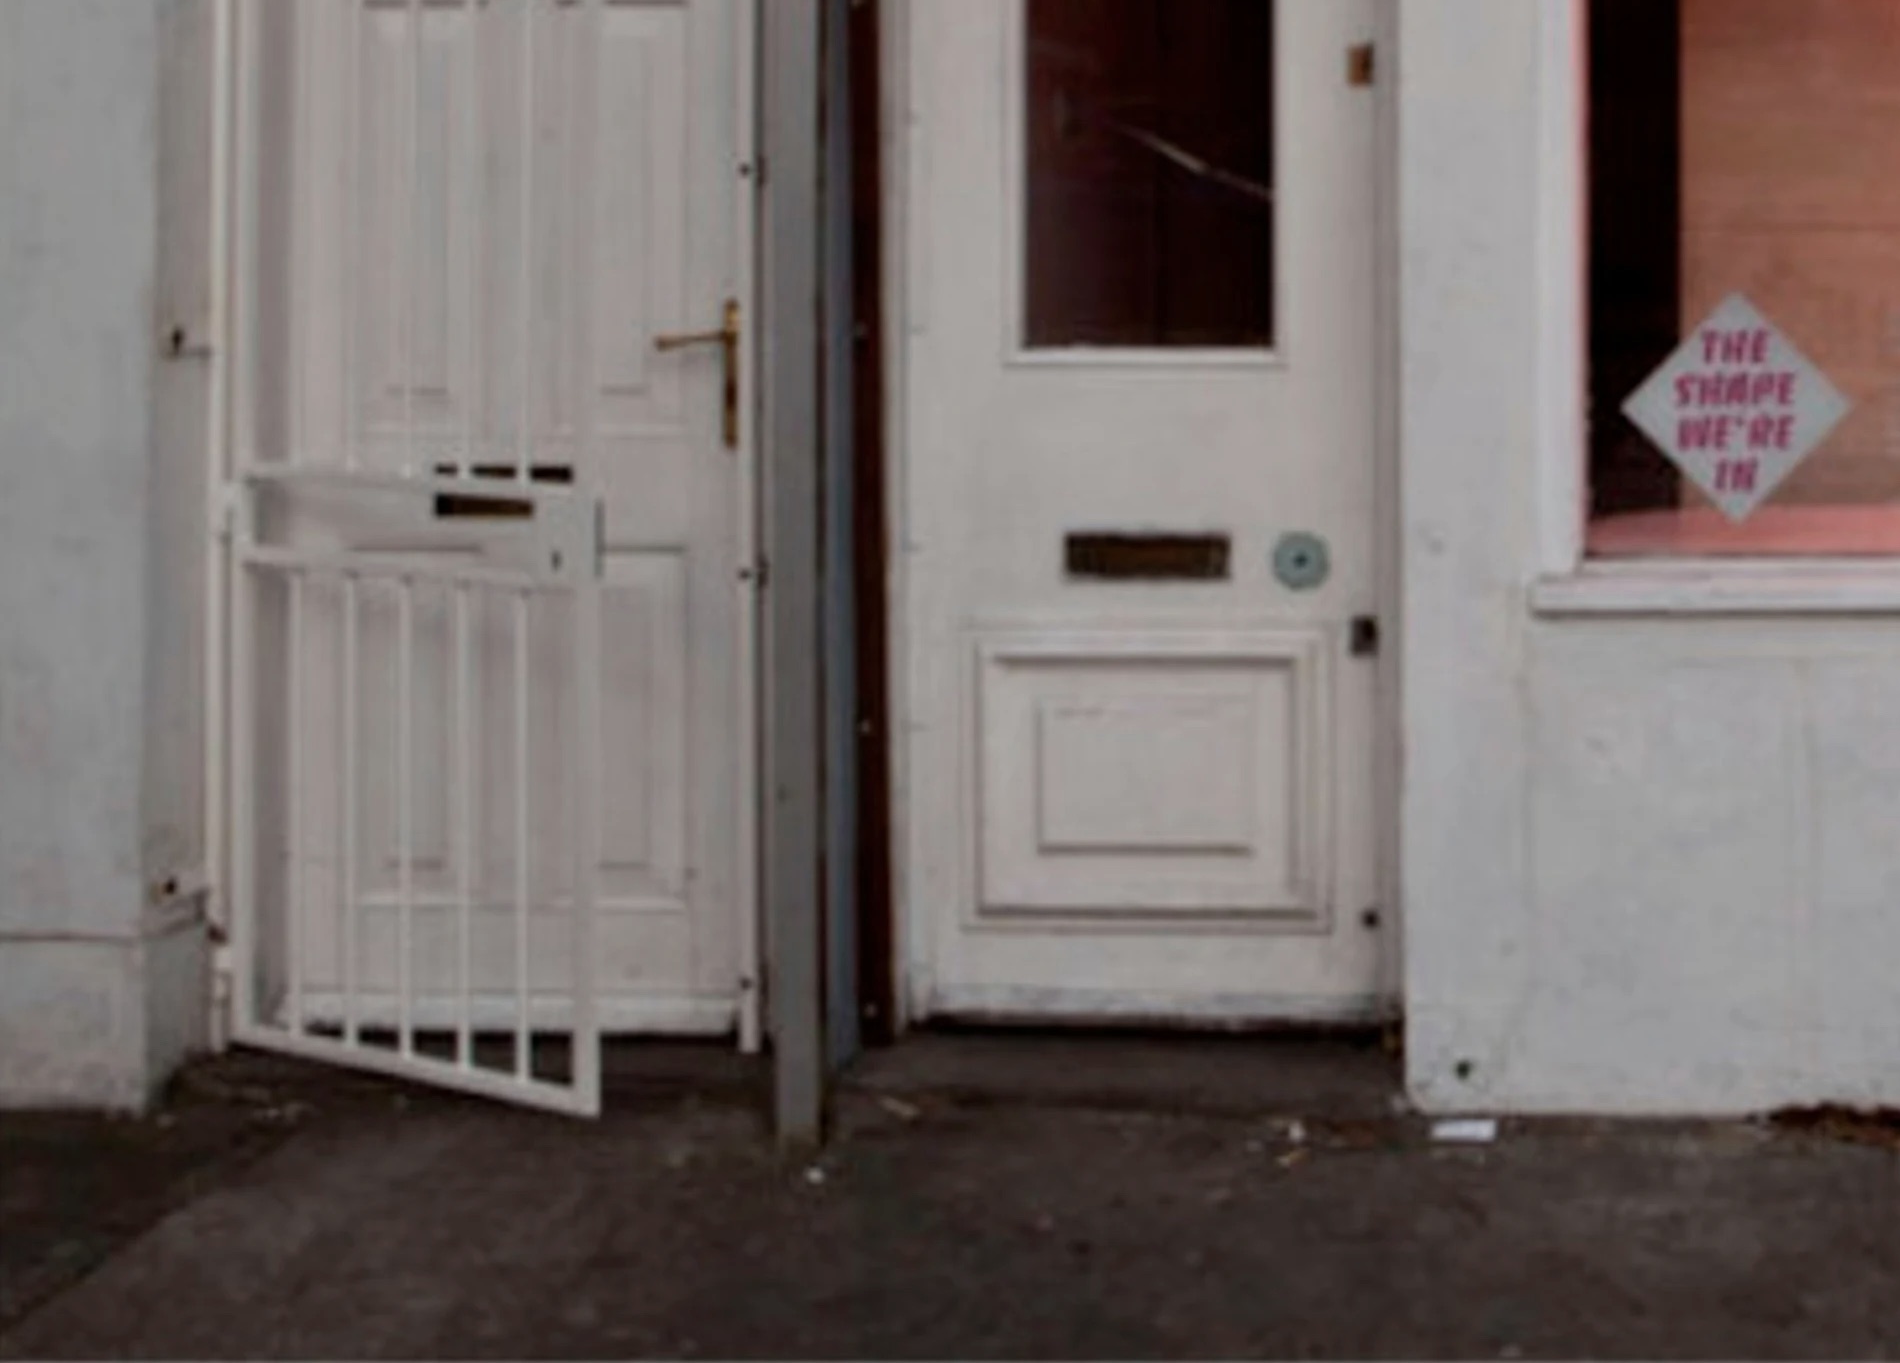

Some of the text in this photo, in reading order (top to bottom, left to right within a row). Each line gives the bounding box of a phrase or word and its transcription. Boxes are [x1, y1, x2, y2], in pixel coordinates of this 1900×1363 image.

[1702, 329, 1770, 364] THE
[1674, 371, 1795, 407] SHAPE
[1676, 414, 1795, 451] WE'RE
[1714, 458, 1759, 491] IN
